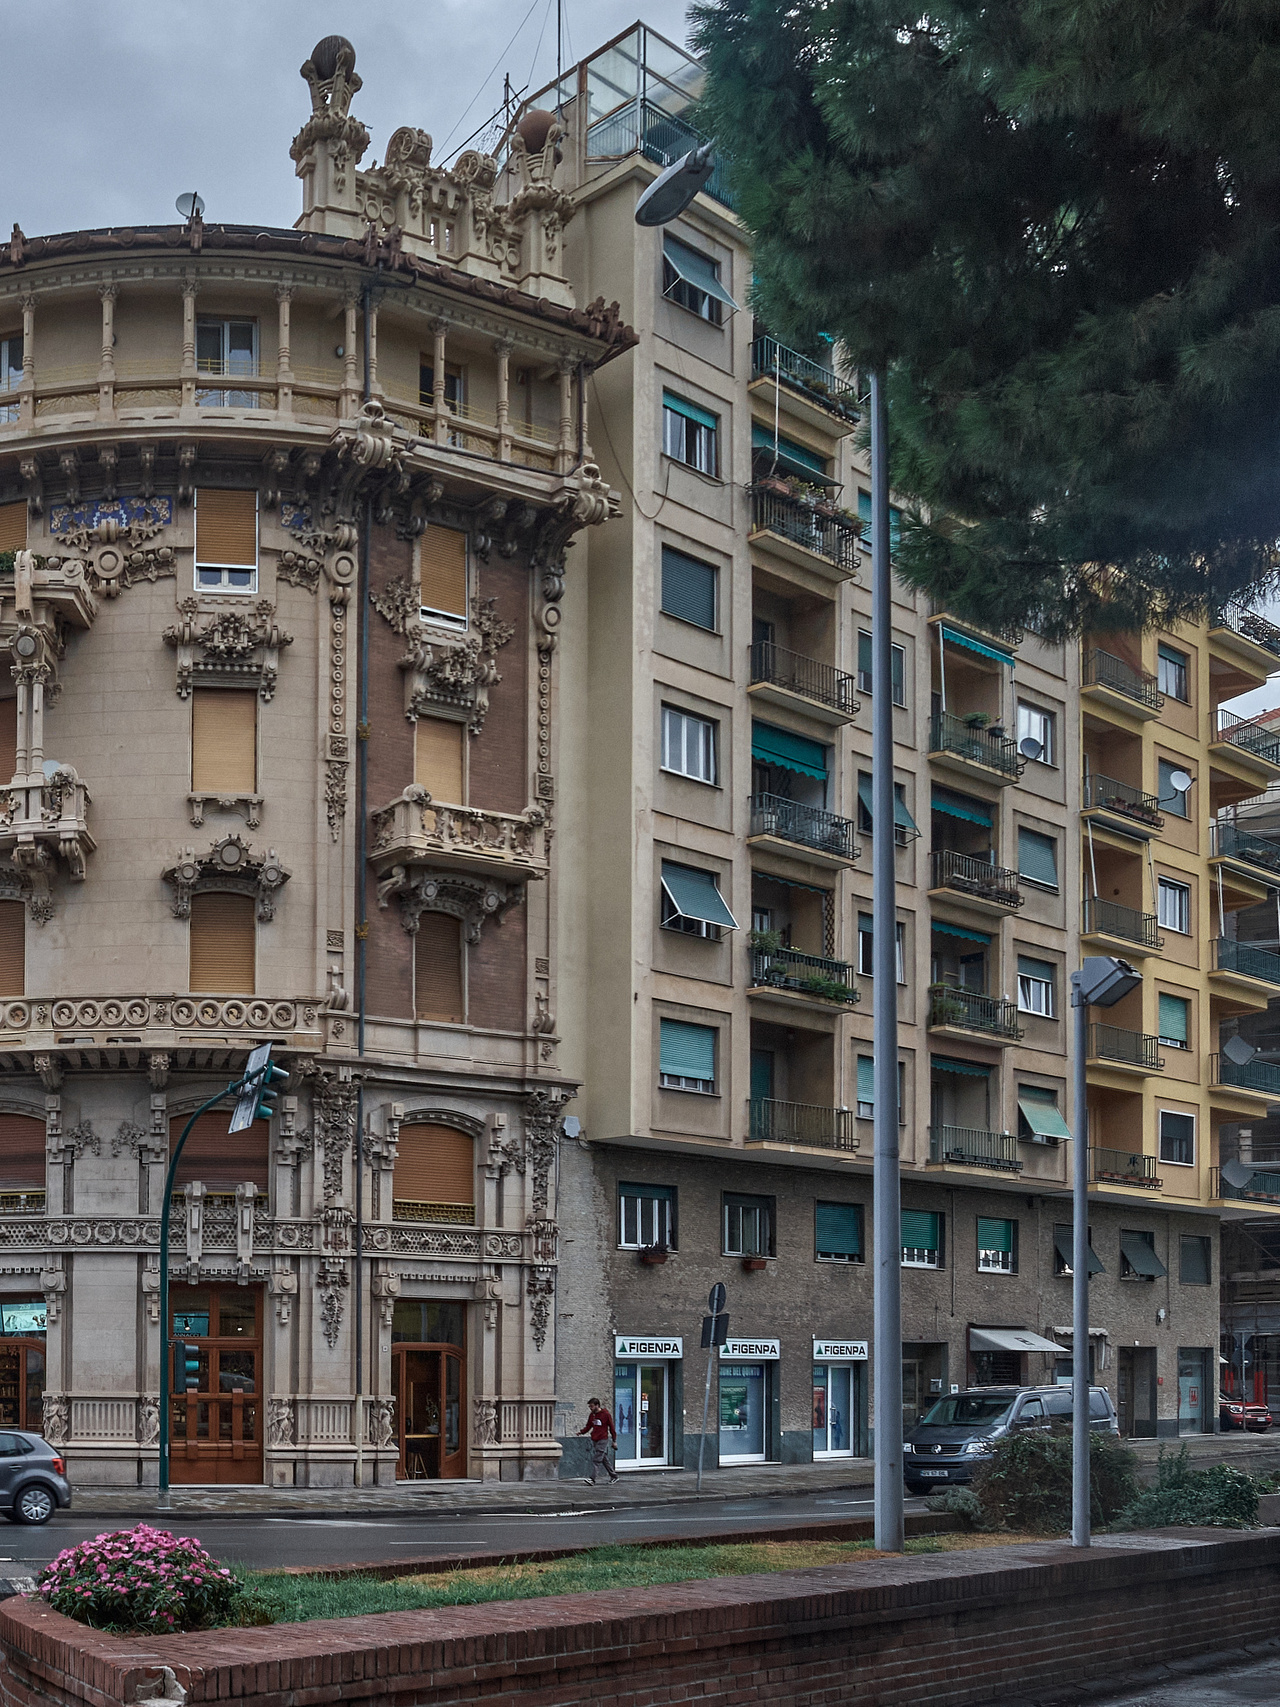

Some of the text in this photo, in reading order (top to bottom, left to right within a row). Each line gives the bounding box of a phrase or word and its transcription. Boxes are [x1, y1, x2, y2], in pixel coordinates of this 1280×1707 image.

[629, 1342, 680, 1354] FIGENPA
[731, 1343, 778, 1355] FIGENPA
[824, 1345, 866, 1356] FIGENPA
